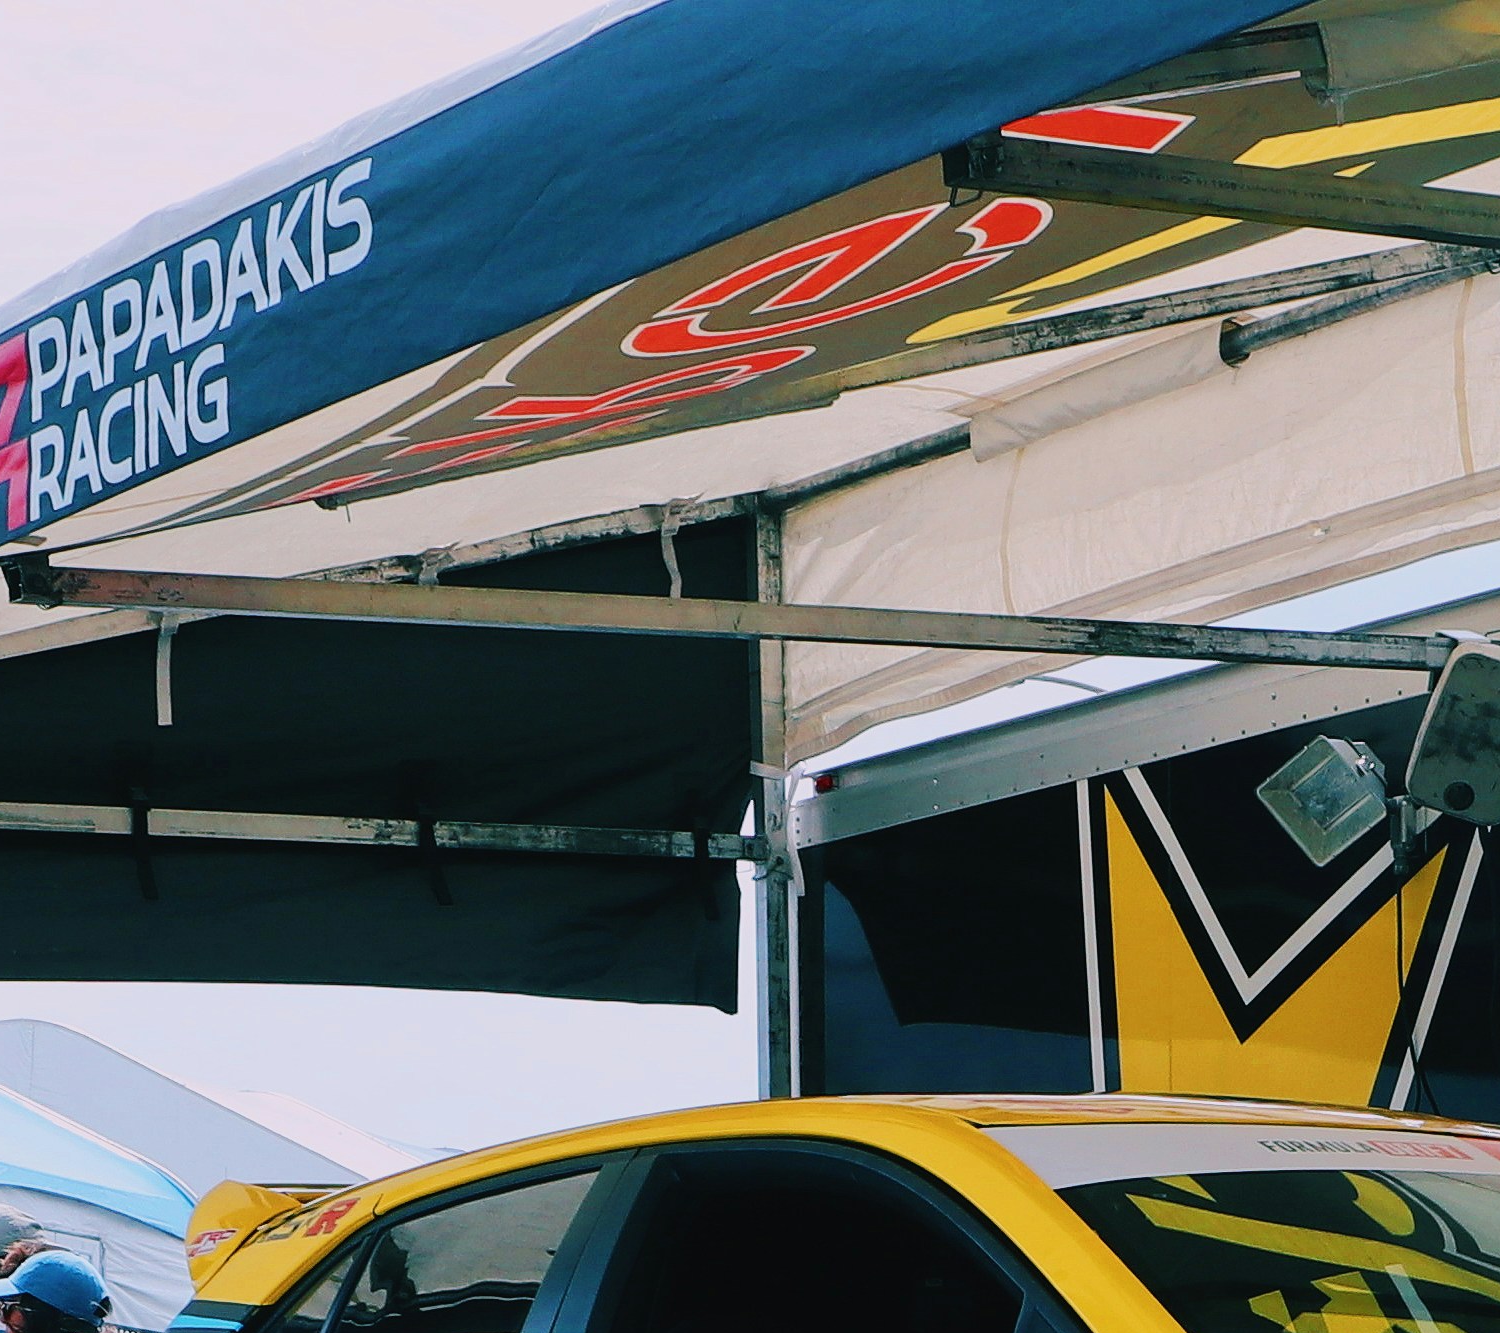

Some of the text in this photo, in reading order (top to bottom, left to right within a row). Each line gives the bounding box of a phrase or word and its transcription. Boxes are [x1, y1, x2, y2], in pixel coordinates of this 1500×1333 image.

[28, 156, 374, 422] PAPADAKIS
[29, 342, 230, 523] RACING
[1257, 1140, 1380, 1154] FORMULA
